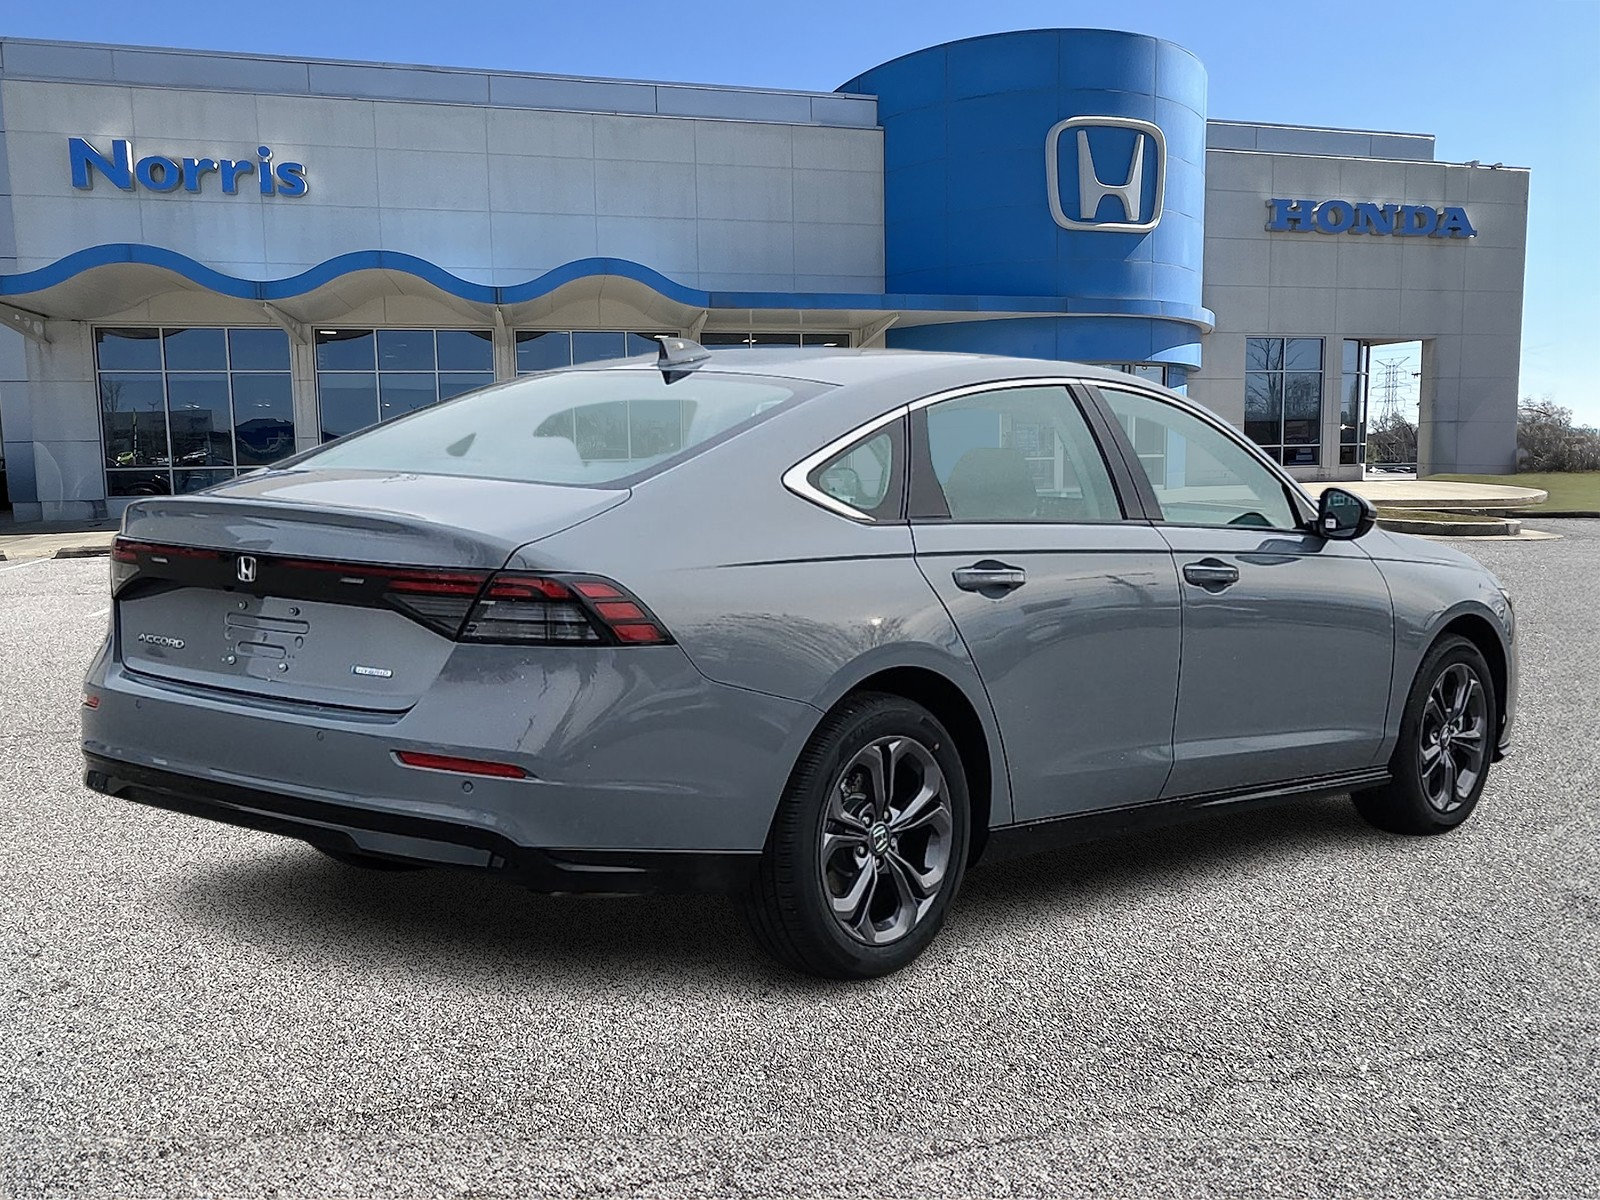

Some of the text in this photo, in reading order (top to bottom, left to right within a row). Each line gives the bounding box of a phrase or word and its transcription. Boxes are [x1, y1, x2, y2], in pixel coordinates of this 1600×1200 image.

[68, 137, 309, 197] Norris
[1266, 198, 1477, 239] HONDA
[138, 633, 185, 649] ACCORD
